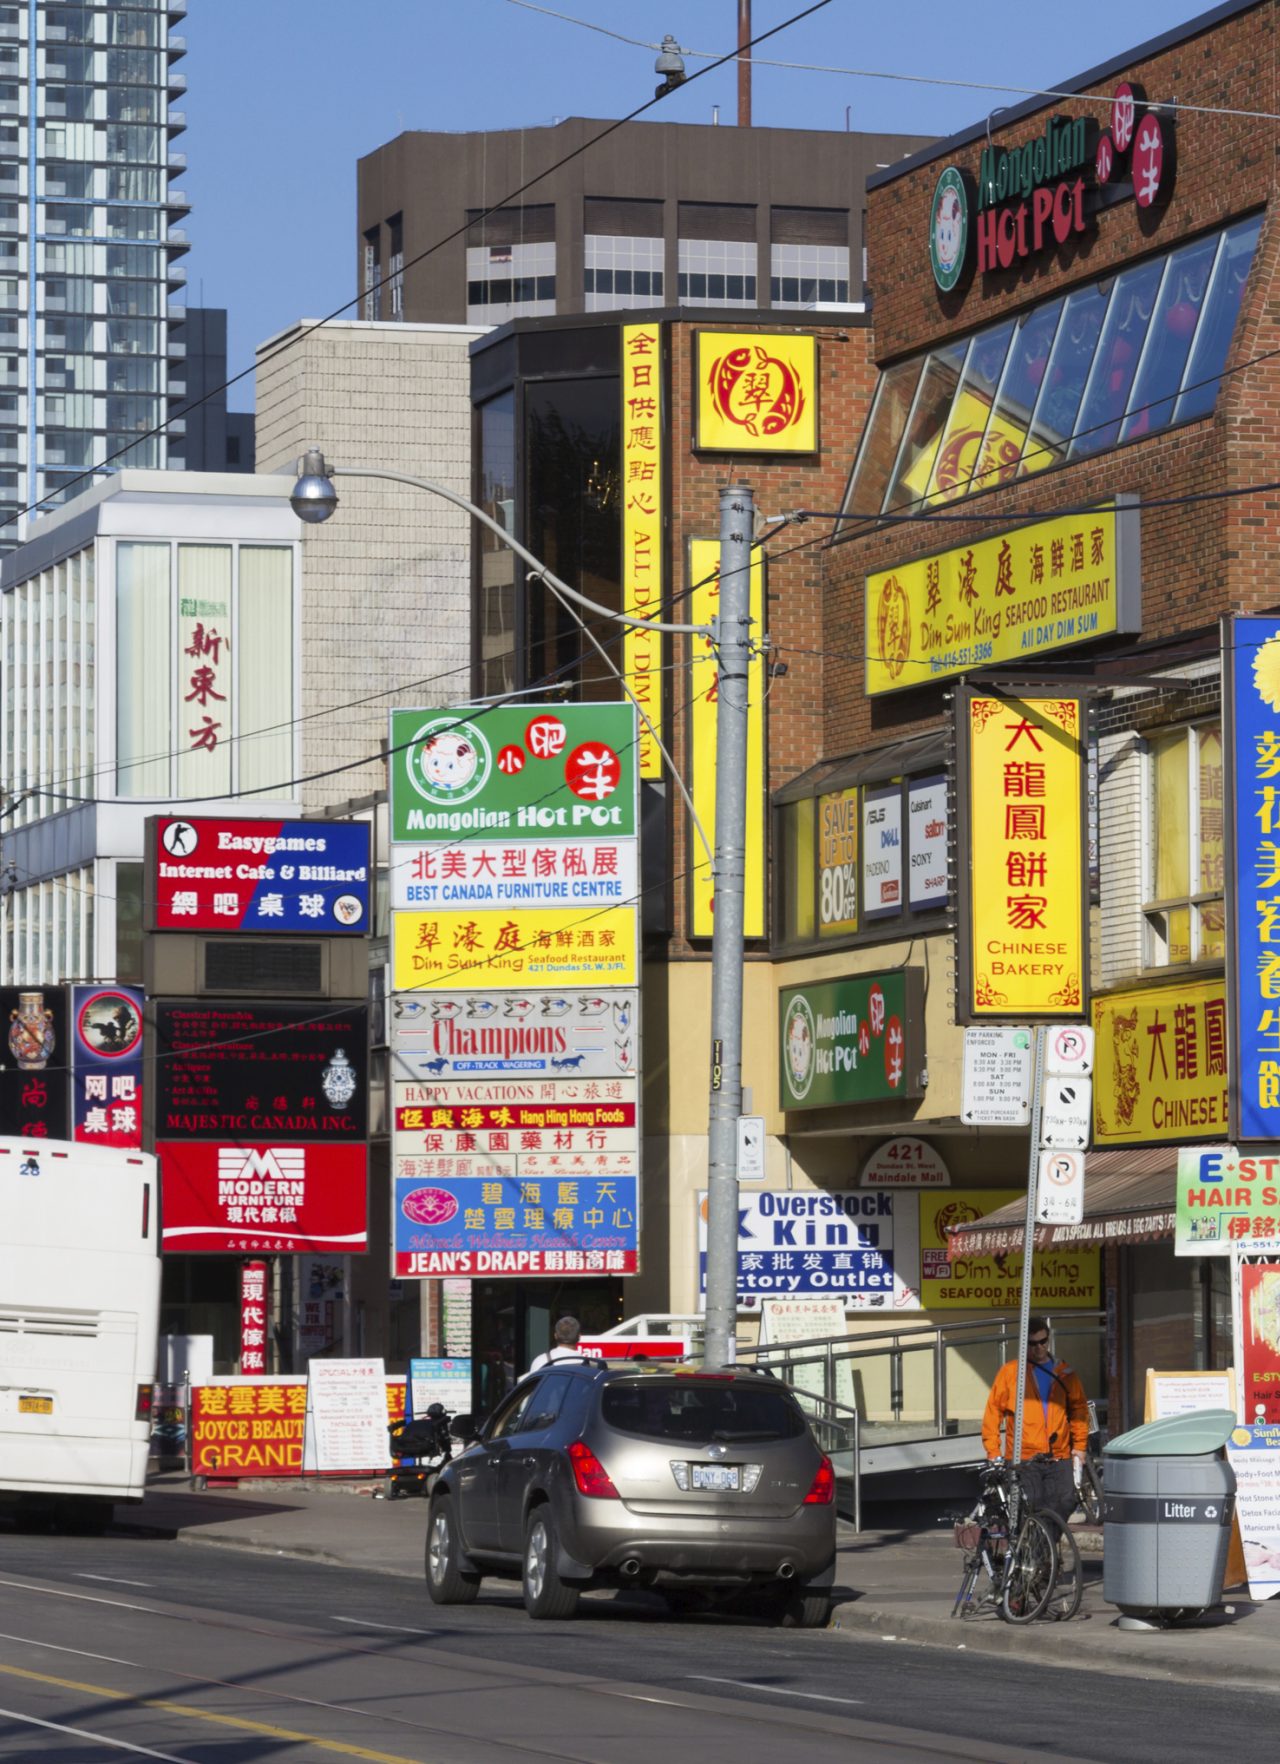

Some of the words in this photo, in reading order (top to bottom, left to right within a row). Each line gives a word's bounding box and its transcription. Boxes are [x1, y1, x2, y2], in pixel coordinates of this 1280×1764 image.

[977, 115, 1086, 209] Mongolian
[627, 332, 656, 514] 全日供應點心
[925, 539, 1015, 616] 翠濠庭
[1030, 526, 1104, 585] 海鮮酒家
[920, 621, 942, 651] Dim
[945, 614, 971, 644] Sum
[973, 607, 1000, 639] King
[1005, 597, 1047, 628] SEAFOOD
[1051, 578, 1110, 615] RESTAURANT
[184, 622, 229, 752] 新東方
[824, 799, 854, 837] SAVE
[1003, 717, 1047, 930] 大龍鳳餅家
[217, 832, 326, 853] Easygames
[881, 827, 899, 848] DELL
[411, 847, 618, 880] 北美大型傢俬展
[912, 852, 933, 867] SONY
[159, 862, 232, 880] Internet
[235, 864, 275, 881] Cafe
[280, 865, 295, 880] &
[298, 865, 366, 882] Billiard
[407, 885, 438, 900] BEST
[442, 885, 493, 900] CANADA
[497, 882, 568, 899] FURNITURE
[572, 881, 622, 897] CENTRE
[171, 890, 326, 917] 網吧桌球
[843, 896, 855, 920] OFF
[415, 921, 526, 952] 翠濠庭
[532, 929, 616, 949] 海鮮酒家
[412, 955, 443, 971] Dim
[447, 954, 481, 970] Sum
[487, 953, 523, 972] King
[528, 954, 566, 964] Seafood
[568, 953, 626, 963] Restaurant
[528, 964, 544, 972] 421
[547, 963, 580, 972] Dundas
[582, 963, 594, 972] St.
[816, 1010, 857, 1040] Mongolian
[433, 1016, 567, 1059] Champions
[457, 1061, 499, 1070] OFF-TRACK
[502, 1060, 541, 1069] WAGERING
[405, 1086, 450, 1101] HAPPY
[457, 1085, 534, 1100] VACATIONS
[167, 1115, 247, 1131] MAJESTIC
[251, 1115, 317, 1130] CANADA
[322, 1115, 357, 1130] INC.
[520, 1110, 544, 1126] Hang
[546, 1109, 568, 1125] Hing
[569, 1109, 594, 1125] Hong
[595, 1108, 625, 1123] Foods
[424, 1130, 607, 1153] 保康園藥材行
[888, 1145, 924, 1160] 421
[218, 1181, 304, 1195] MODERN
[868, 1172, 917, 1183] Maindale
[921, 1172, 944, 1183] Mall
[218, 1196, 304, 1206] FURNITURE
[481, 1181, 617, 1205] 碧海藍天
[1187, 1187, 1251, 1207] HAIR
[227, 1207, 297, 1223] 現代傢俬
[759, 1192, 893, 1217] Overstock
[464, 1207, 633, 1230] 楚雲理療中心
[409, 1235, 463, 1249] Miracle
[467, 1234, 528, 1249] Wellness
[531, 1233, 578, 1248] Health
[581, 1233, 627, 1248] Centre
[773, 1220, 880, 1248] King
[408, 1252, 471, 1273] JEAN'S
[477, 1251, 540, 1272] DRAPE
[940, 1287, 1001, 1298] SEAFOOD
[1254, 1391, 1271, 1399] Hair
[201, 1446, 304, 1467] GRAND
[1164, 1502, 1197, 1518] Litter
